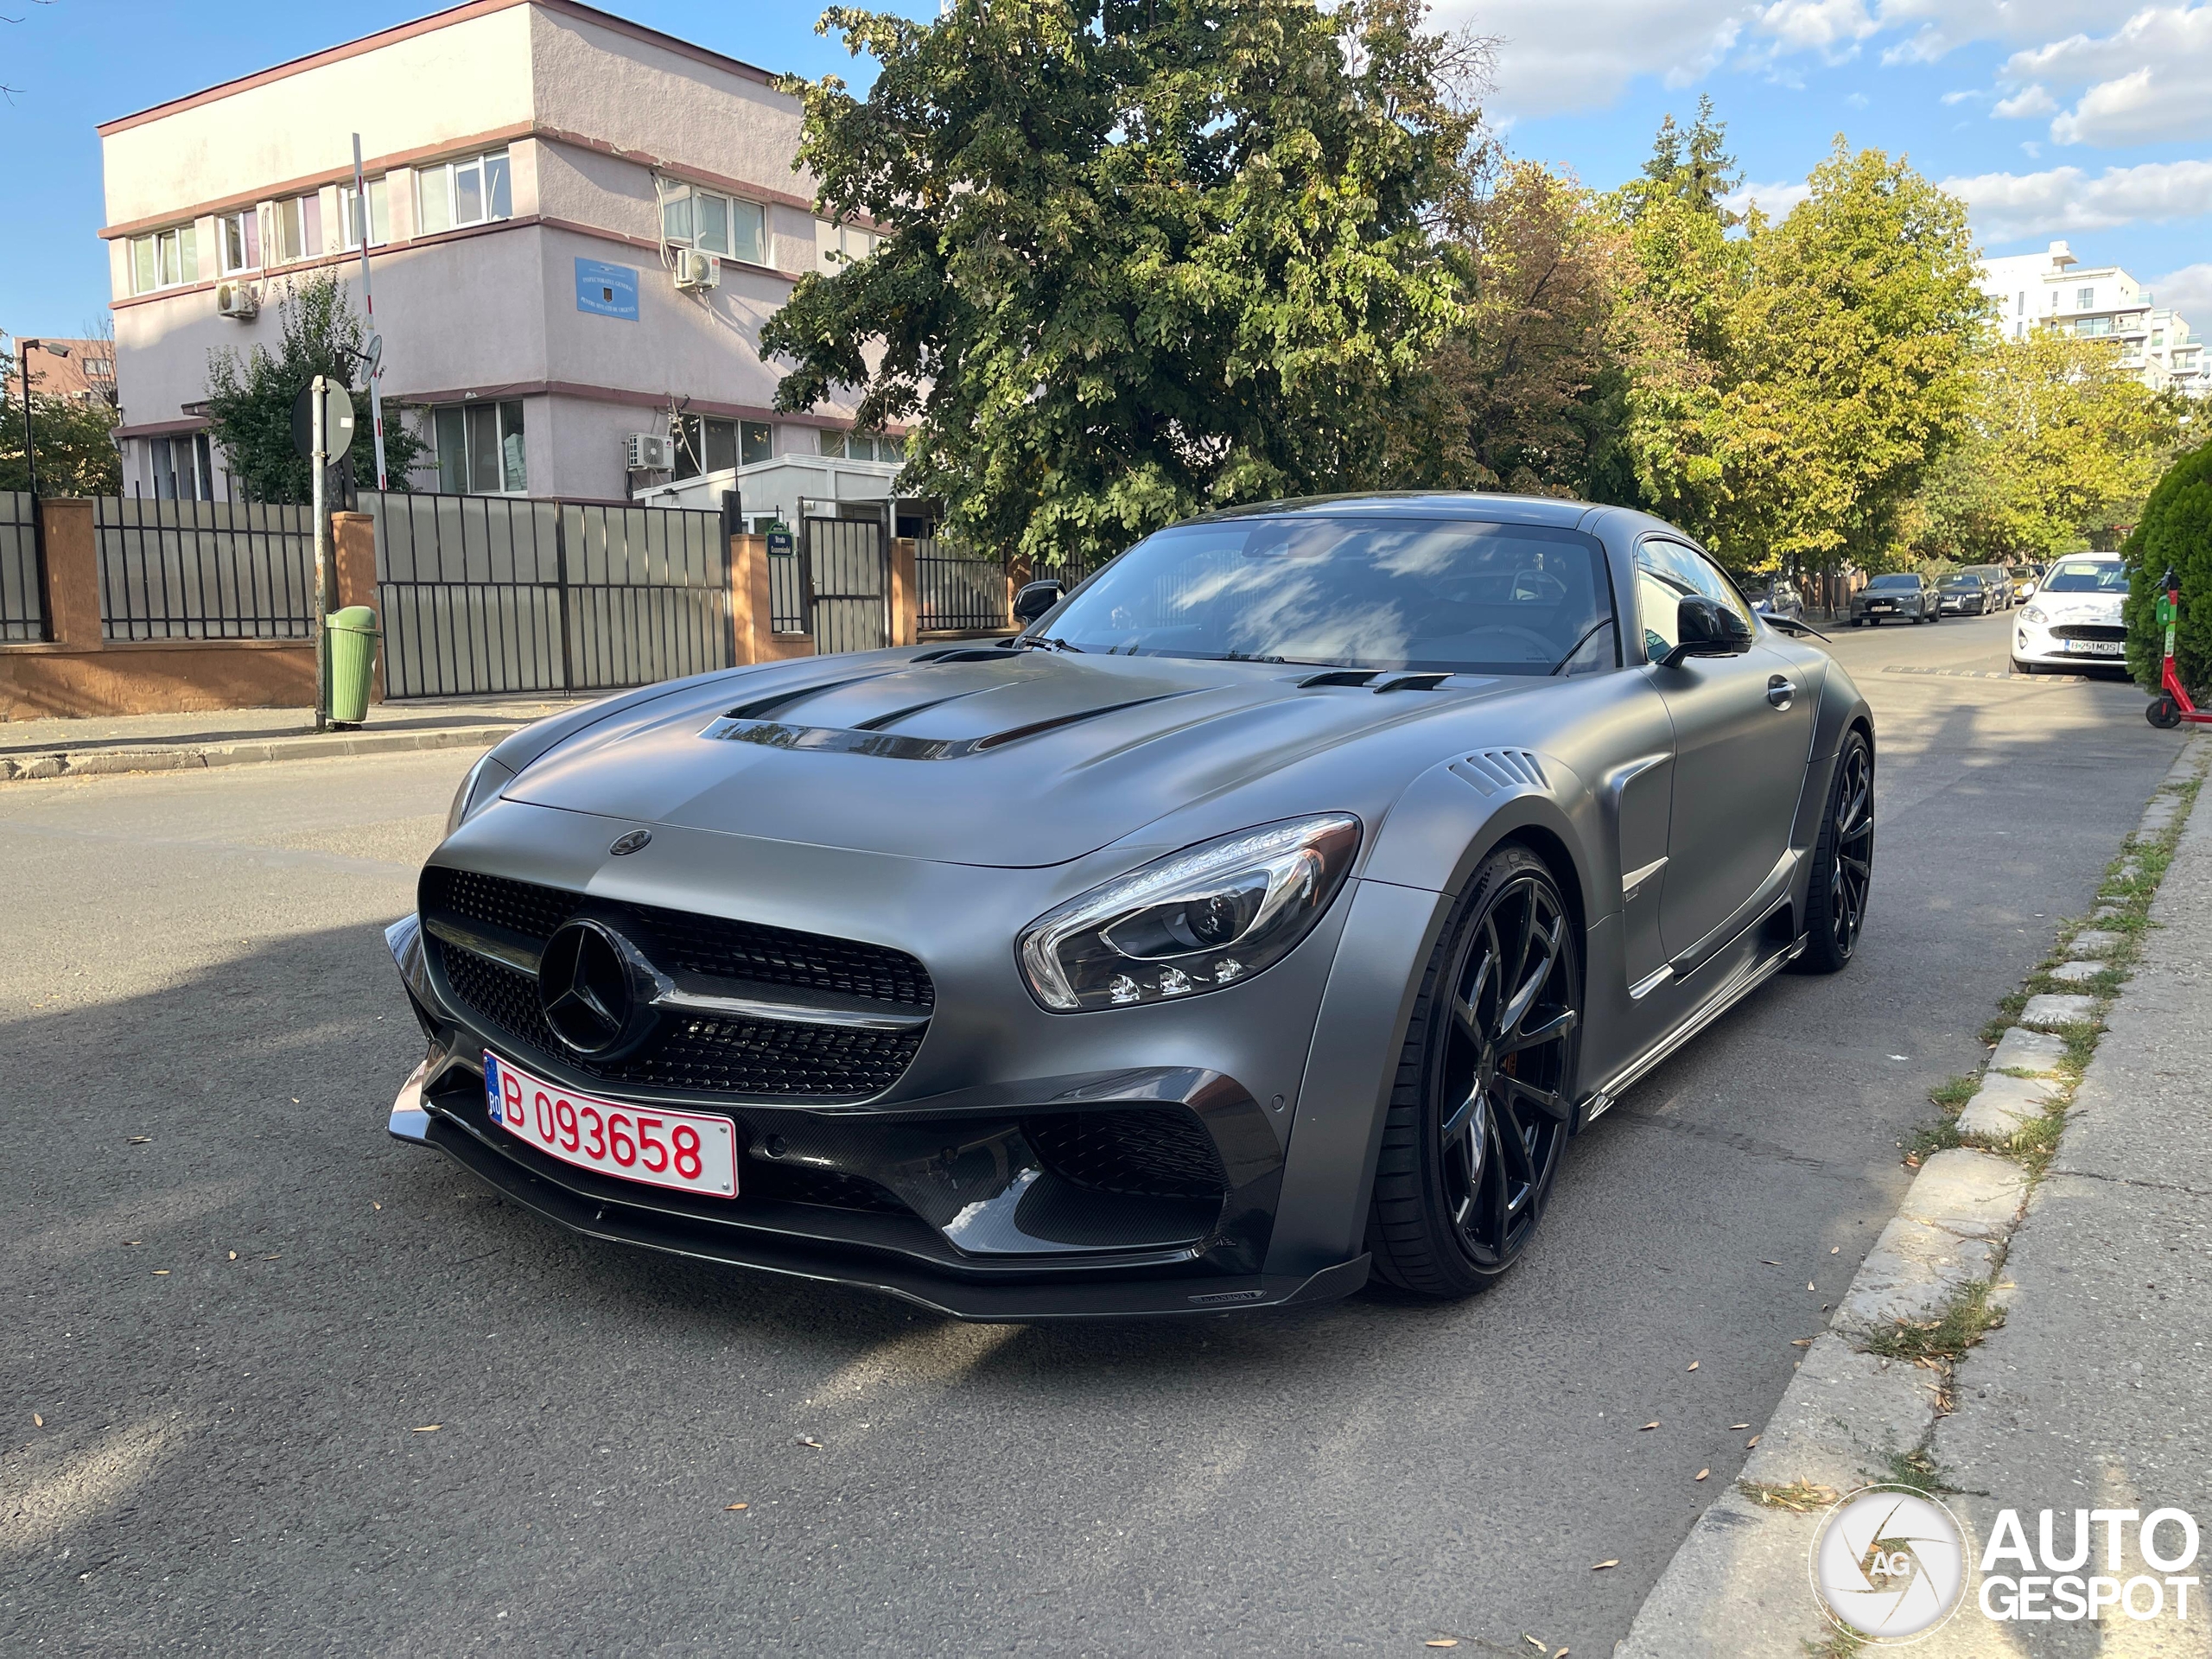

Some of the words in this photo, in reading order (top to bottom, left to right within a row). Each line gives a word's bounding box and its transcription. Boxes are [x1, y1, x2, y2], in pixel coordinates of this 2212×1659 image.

[582, 276, 614, 285] INSPECTORATUL
[615, 281, 633, 292] GENERAL
[581, 296, 595, 308] PENTRU
[488, 1090, 501, 1116] RO
[502, 1071, 524, 1128] B
[534, 1090, 703, 1180] 093658
